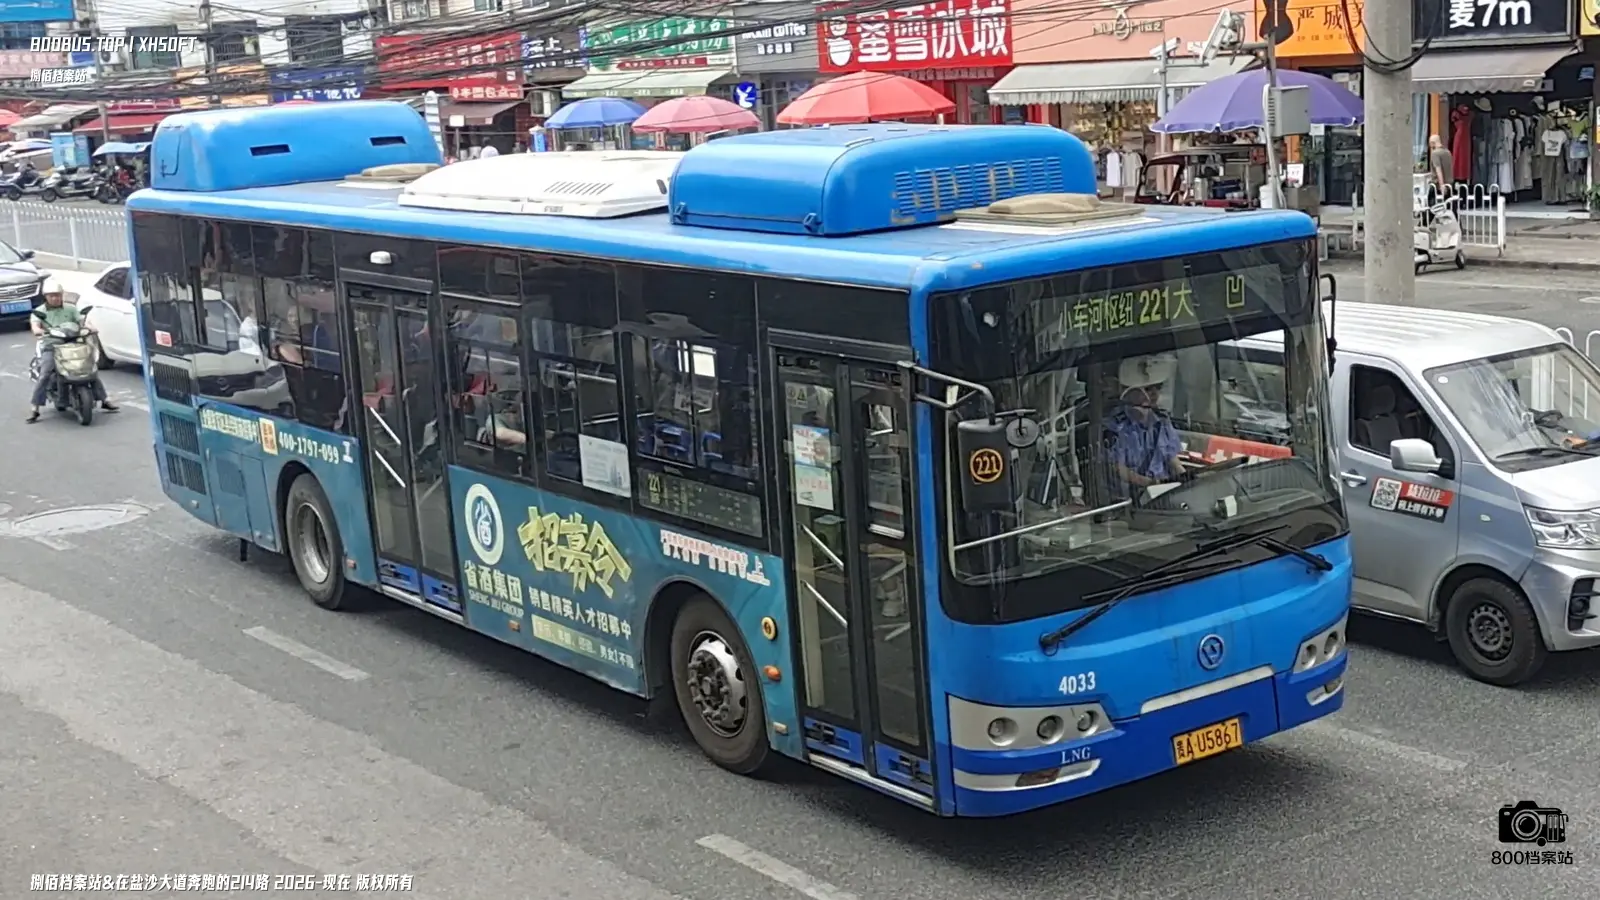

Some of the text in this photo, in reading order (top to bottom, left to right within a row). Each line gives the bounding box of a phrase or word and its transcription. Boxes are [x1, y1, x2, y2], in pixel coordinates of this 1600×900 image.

[856, 0, 1009, 62] 蜜雪冰城
[1058, 292, 1134, 339] 小车河枢纽
[1139, 286, 1169, 324] 221
[278, 431, 339, 464] 400-1797-099
[975, 456, 998, 475] 221
[517, 506, 632, 599] 招募令
[464, 559, 524, 607] 省酒集团
[1058, 671, 1096, 695] 4033
[1060, 746, 1091, 765] LNG
